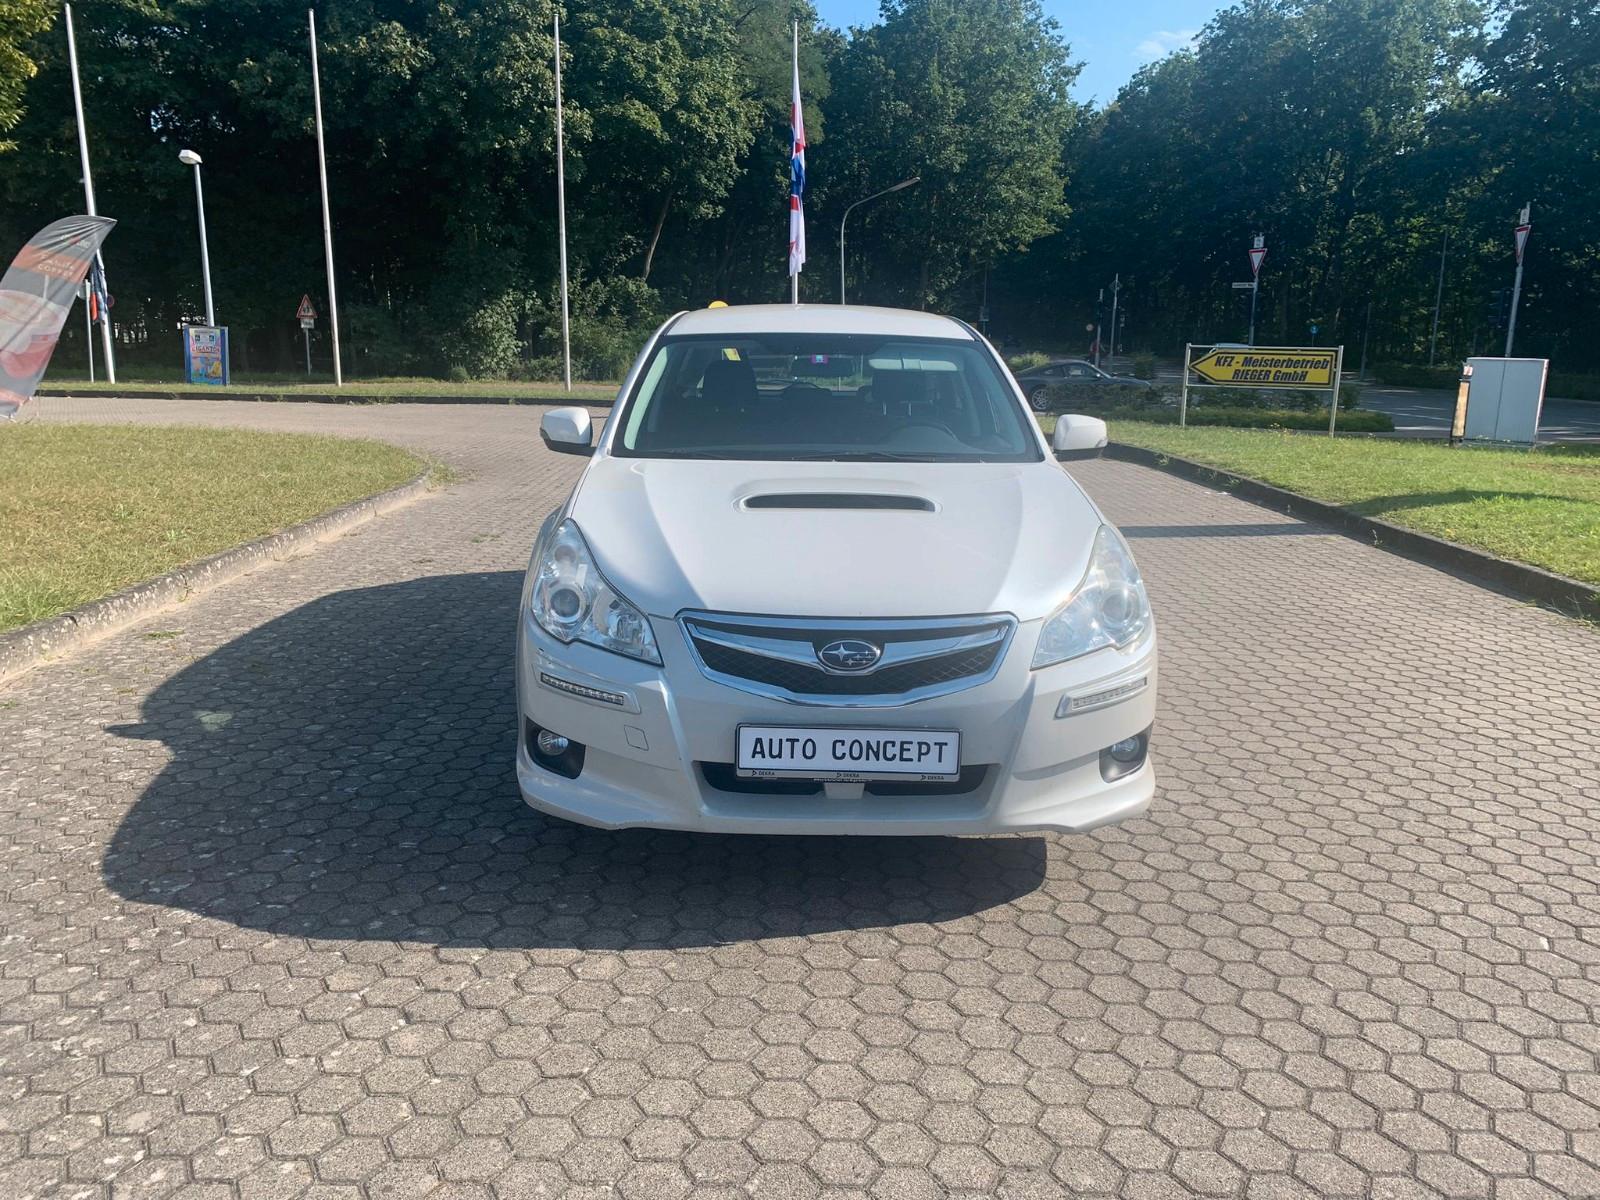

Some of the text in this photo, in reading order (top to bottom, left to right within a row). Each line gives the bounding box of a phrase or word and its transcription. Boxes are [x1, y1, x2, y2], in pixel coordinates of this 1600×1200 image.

[1214, 355, 1235, 367] KFZ
[1241, 356, 1329, 370] Meisterbetrieb
[1232, 369, 1309, 382] RIEGER GmbH
[751, 737, 948, 763] AUTO CONCEPT
